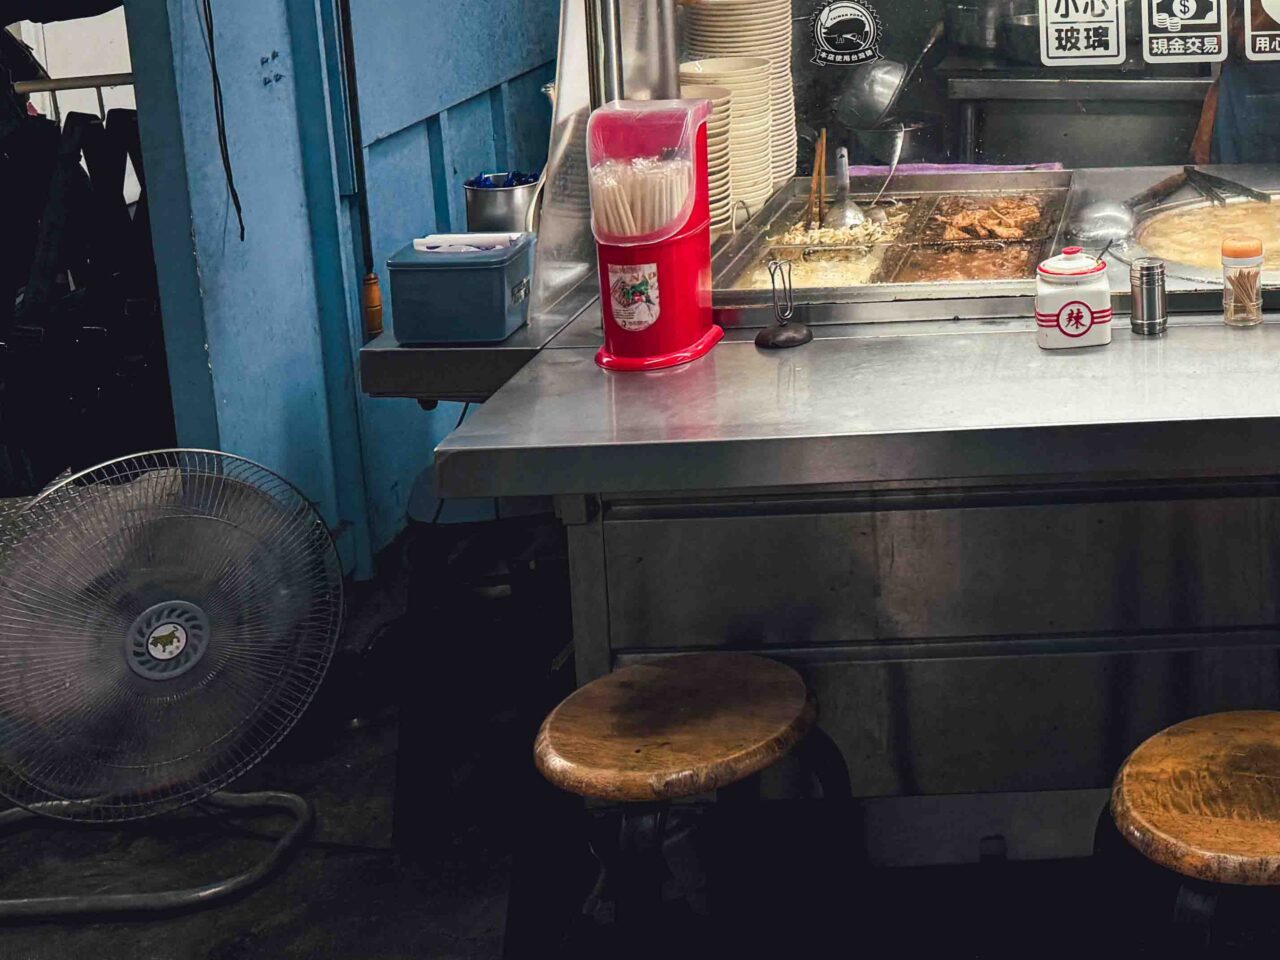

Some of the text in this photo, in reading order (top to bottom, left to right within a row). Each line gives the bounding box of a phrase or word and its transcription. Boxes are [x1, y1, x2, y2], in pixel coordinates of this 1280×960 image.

[1055, 26, 1110, 52] 玻璃
[1152, 37, 1219, 55] 現金交易
[1065, 308, 1087, 329] 辣
